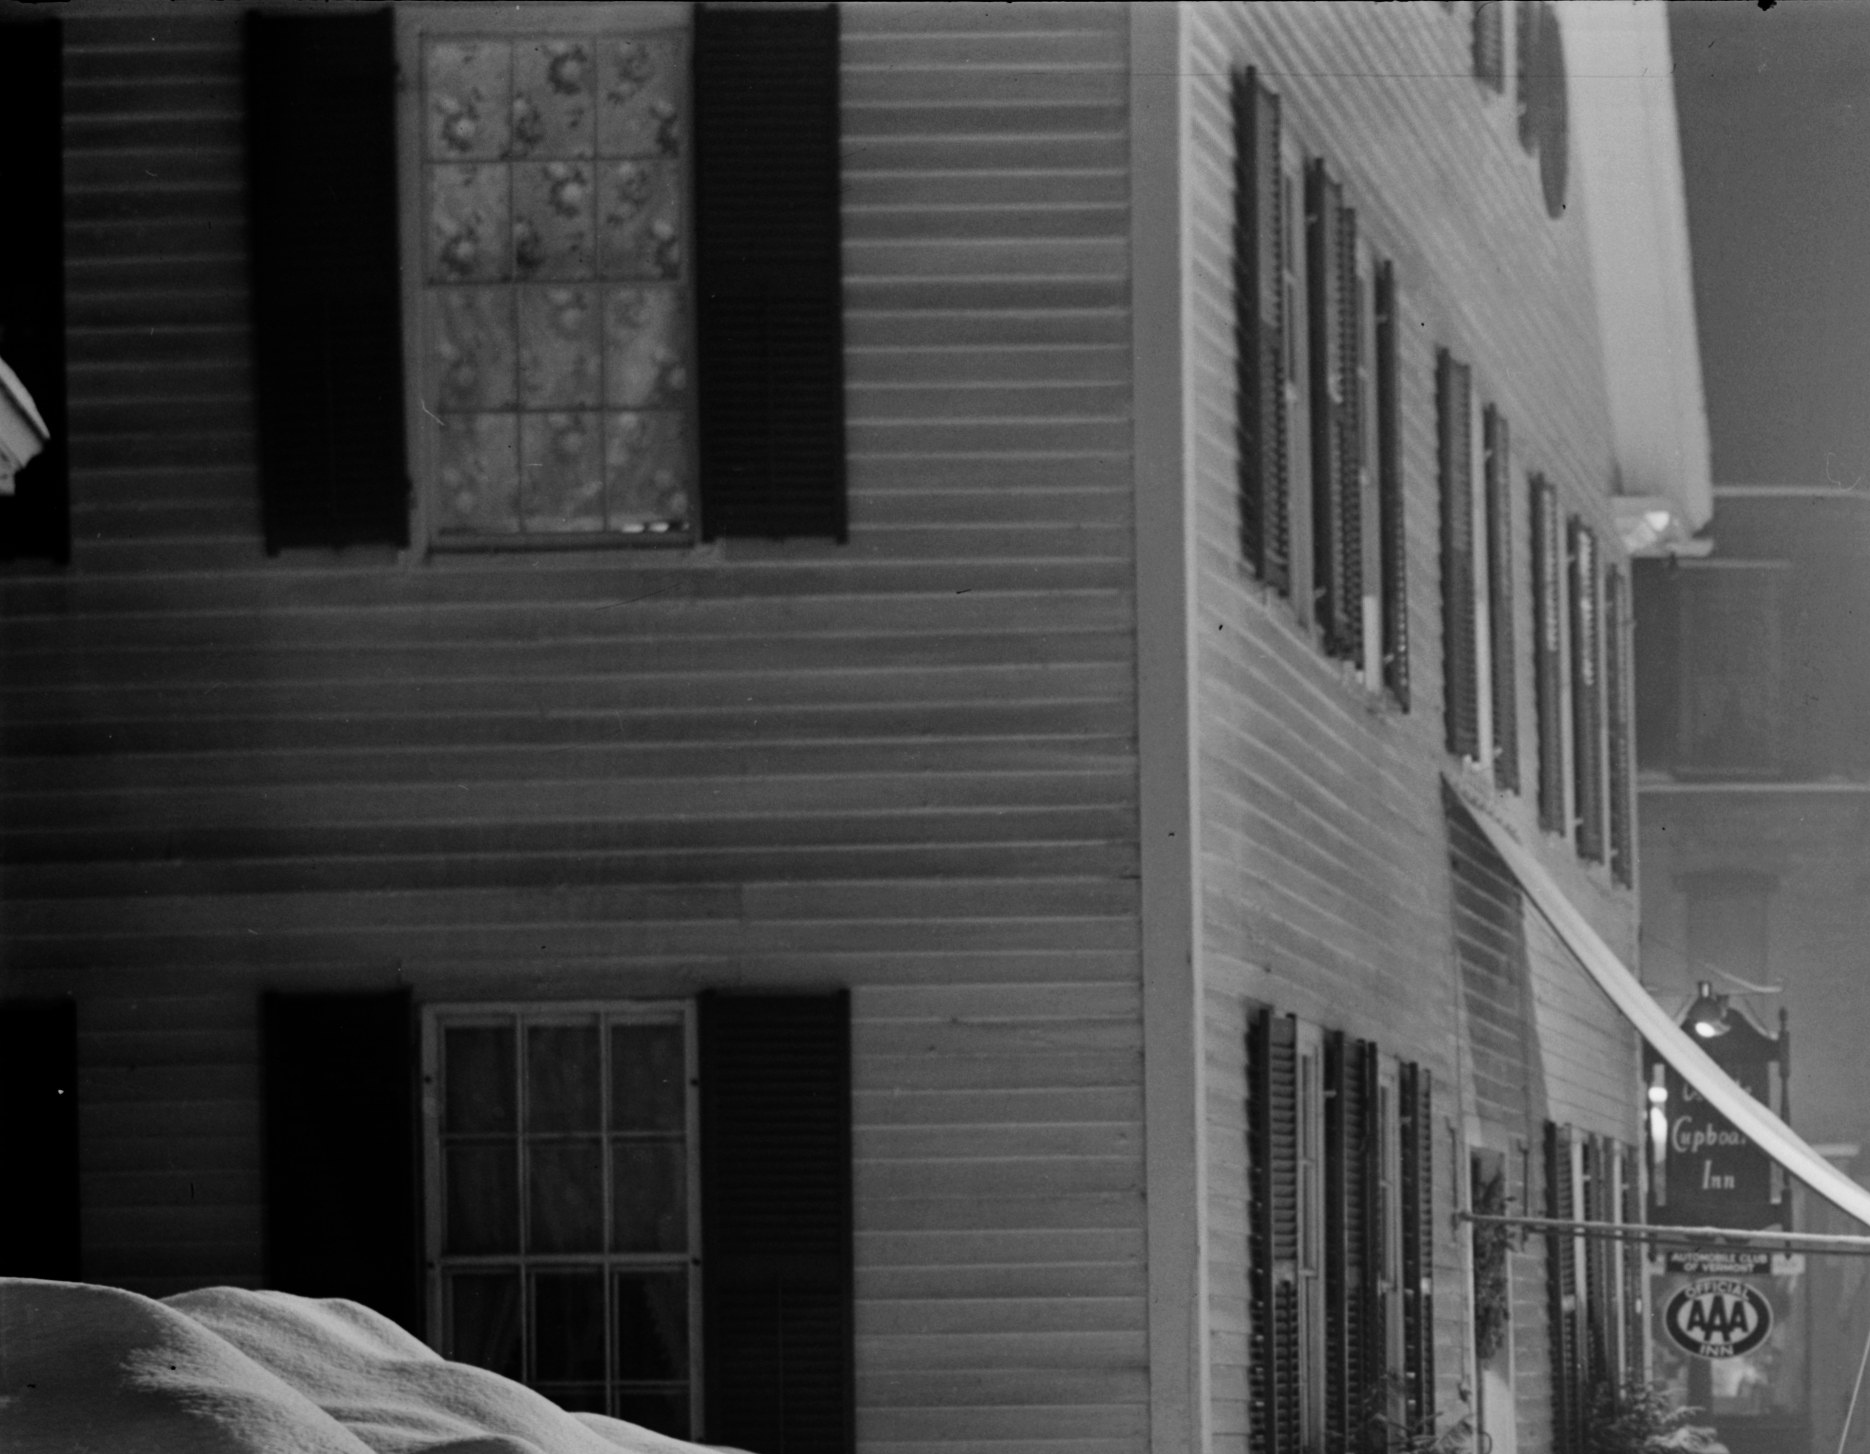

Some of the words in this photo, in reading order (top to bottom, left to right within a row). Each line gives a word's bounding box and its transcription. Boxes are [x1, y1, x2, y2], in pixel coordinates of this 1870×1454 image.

[1671, 1115, 1747, 1153] Cupboa
[1702, 1159, 1735, 1190] Inn
[1671, 1252, 1736, 1262] AUTOMOBILE
[1739, 1253, 1768, 1263] CLUB
[1683, 1263, 1698, 1271] OF
[1702, 1263, 1755, 1272] VERMONT
[1684, 1281, 1750, 1301] OFFICIAL
[1686, 1294, 1749, 1341] AAA
[1699, 1344, 1734, 1356] INN
